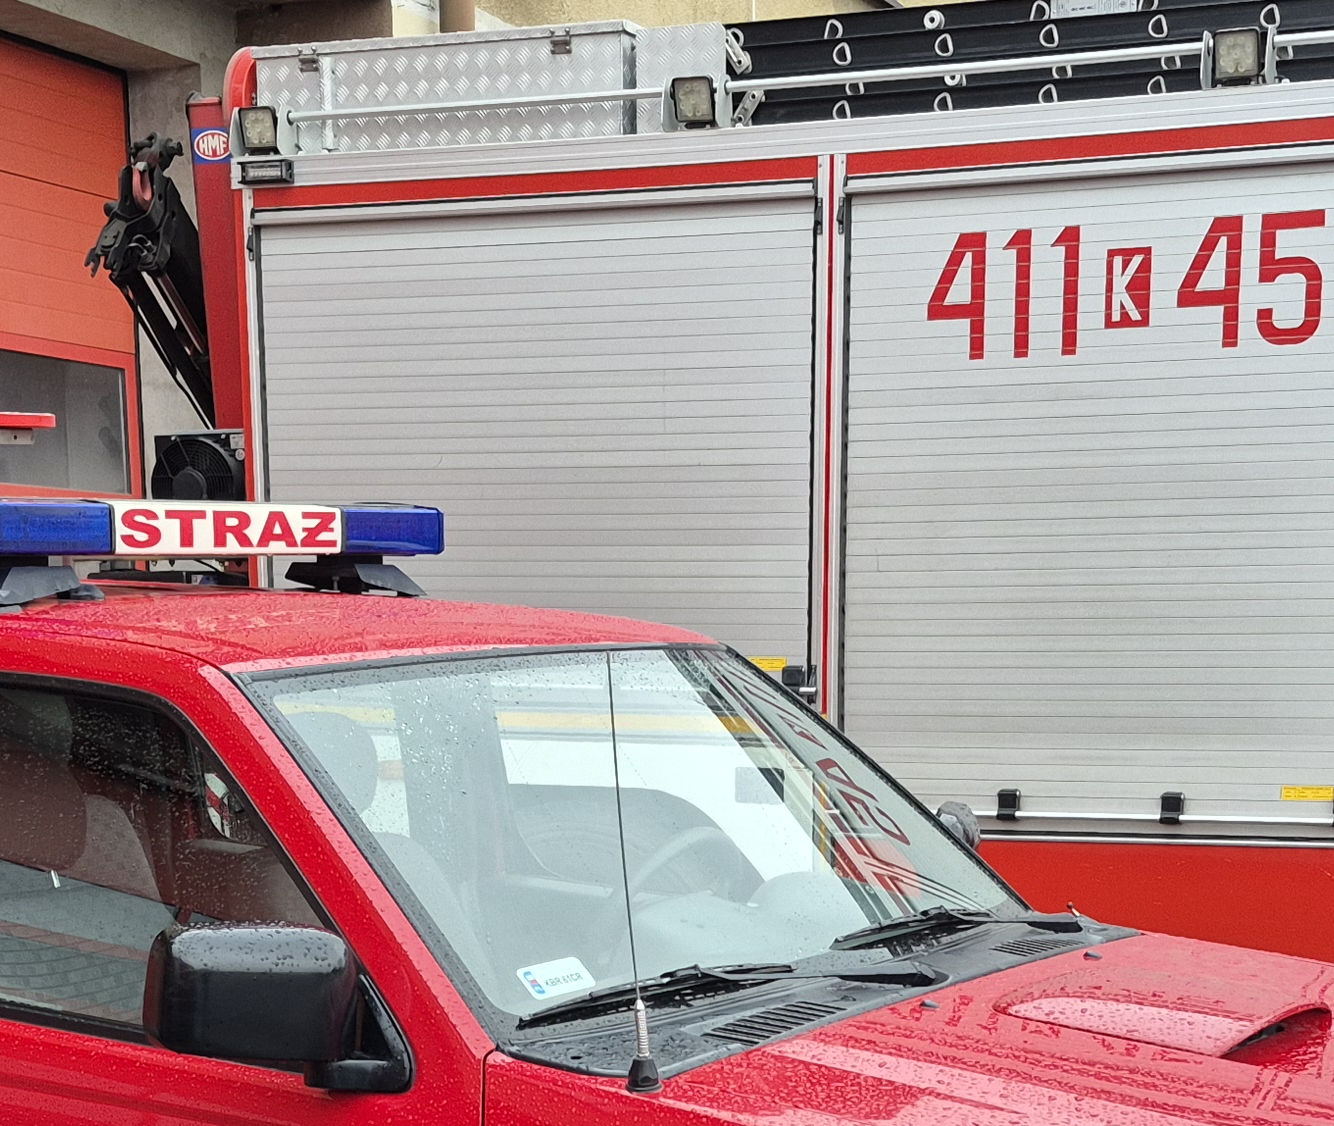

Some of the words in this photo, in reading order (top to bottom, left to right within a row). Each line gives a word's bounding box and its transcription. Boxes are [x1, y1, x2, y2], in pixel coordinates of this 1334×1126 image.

[197, 133, 227, 158] HMF
[927, 225, 1080, 360] 411
[1107, 250, 1149, 326] K
[1177, 208, 1325, 346] 45
